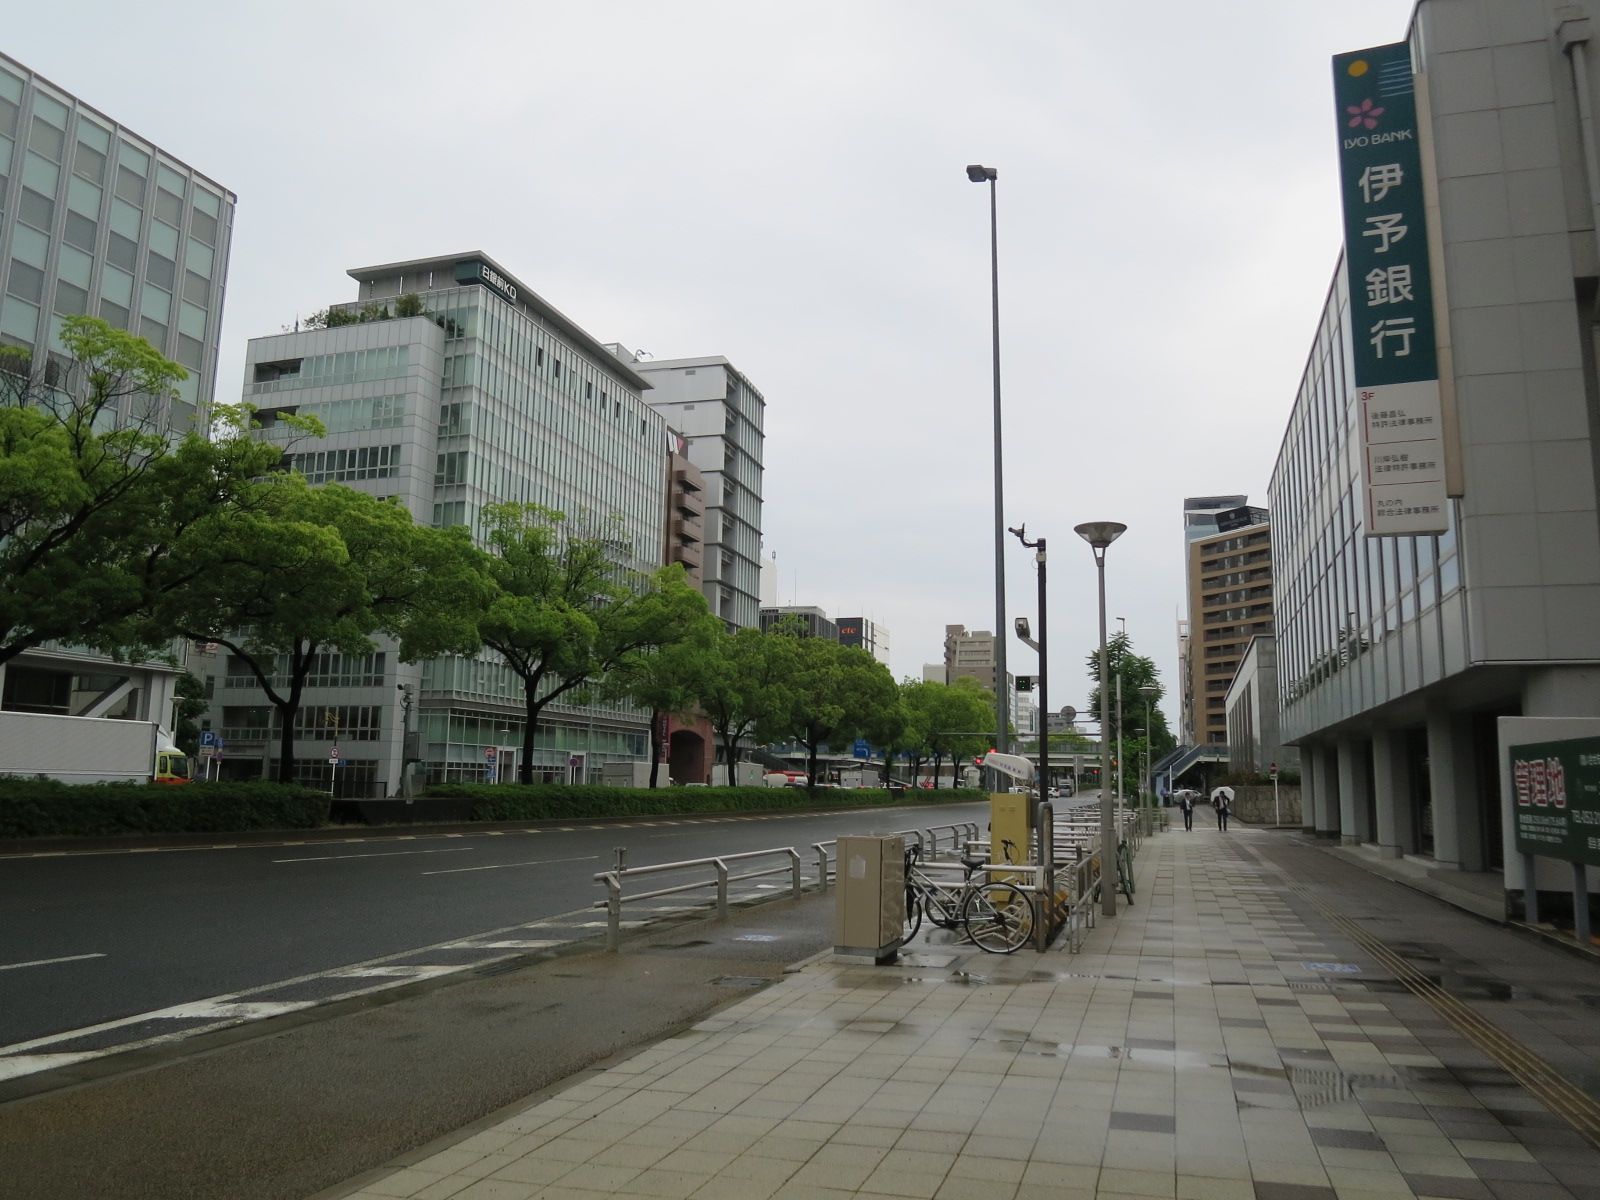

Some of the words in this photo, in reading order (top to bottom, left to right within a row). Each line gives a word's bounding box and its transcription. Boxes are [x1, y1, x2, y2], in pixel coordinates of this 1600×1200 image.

[1344, 135, 1369, 150] IYO
[1371, 129, 1413, 146] BANK
[1358, 163, 1416, 358] 伊予銀行
[1361, 391, 1375, 401] 3F
[204, 734, 213, 744] P
[1515, 757, 1567, 808] 管理地
